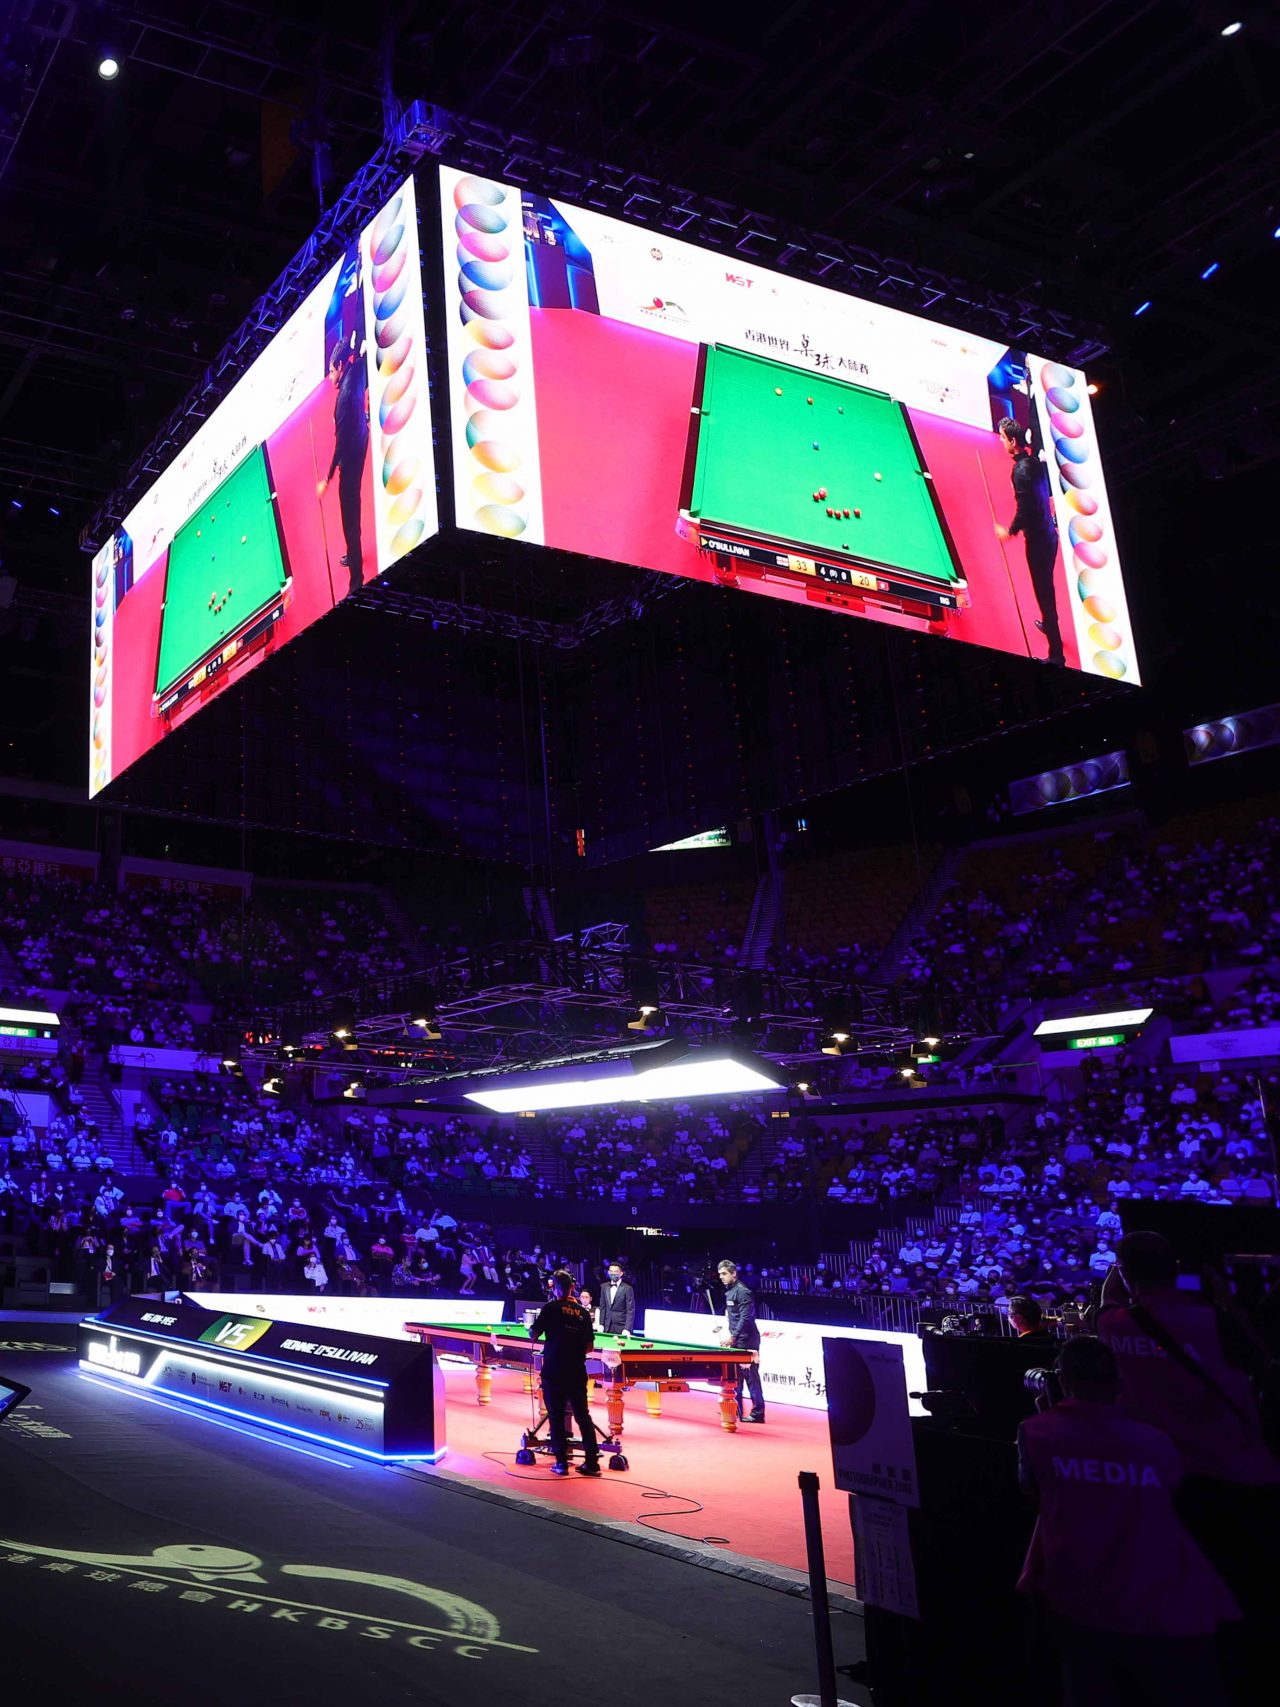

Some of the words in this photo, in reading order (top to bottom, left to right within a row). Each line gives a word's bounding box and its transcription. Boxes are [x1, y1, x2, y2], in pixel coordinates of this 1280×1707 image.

[725, 272, 754, 289] WST
[708, 539, 750, 557] O'SULLIVAN
[796, 559, 808, 572] 33
[820, 566, 826, 576] 4
[859, 575, 870, 587] 20
[939, 595, 951, 606] NG
[0, 1026, 17, 1035] EXIT
[1076, 1038, 1097, 1048] EXIT
[631, 1206, 638, 1215] B
[214, 1321, 255, 1346] VS
[280, 1339, 319, 1354] RONNIE
[313, 1345, 379, 1366] O'SULLIVAN
[1110, 1334, 1201, 1363] MEA
[1051, 1455, 1162, 1488] MEDIA
[227, 1599, 490, 1660] HKBSCC
